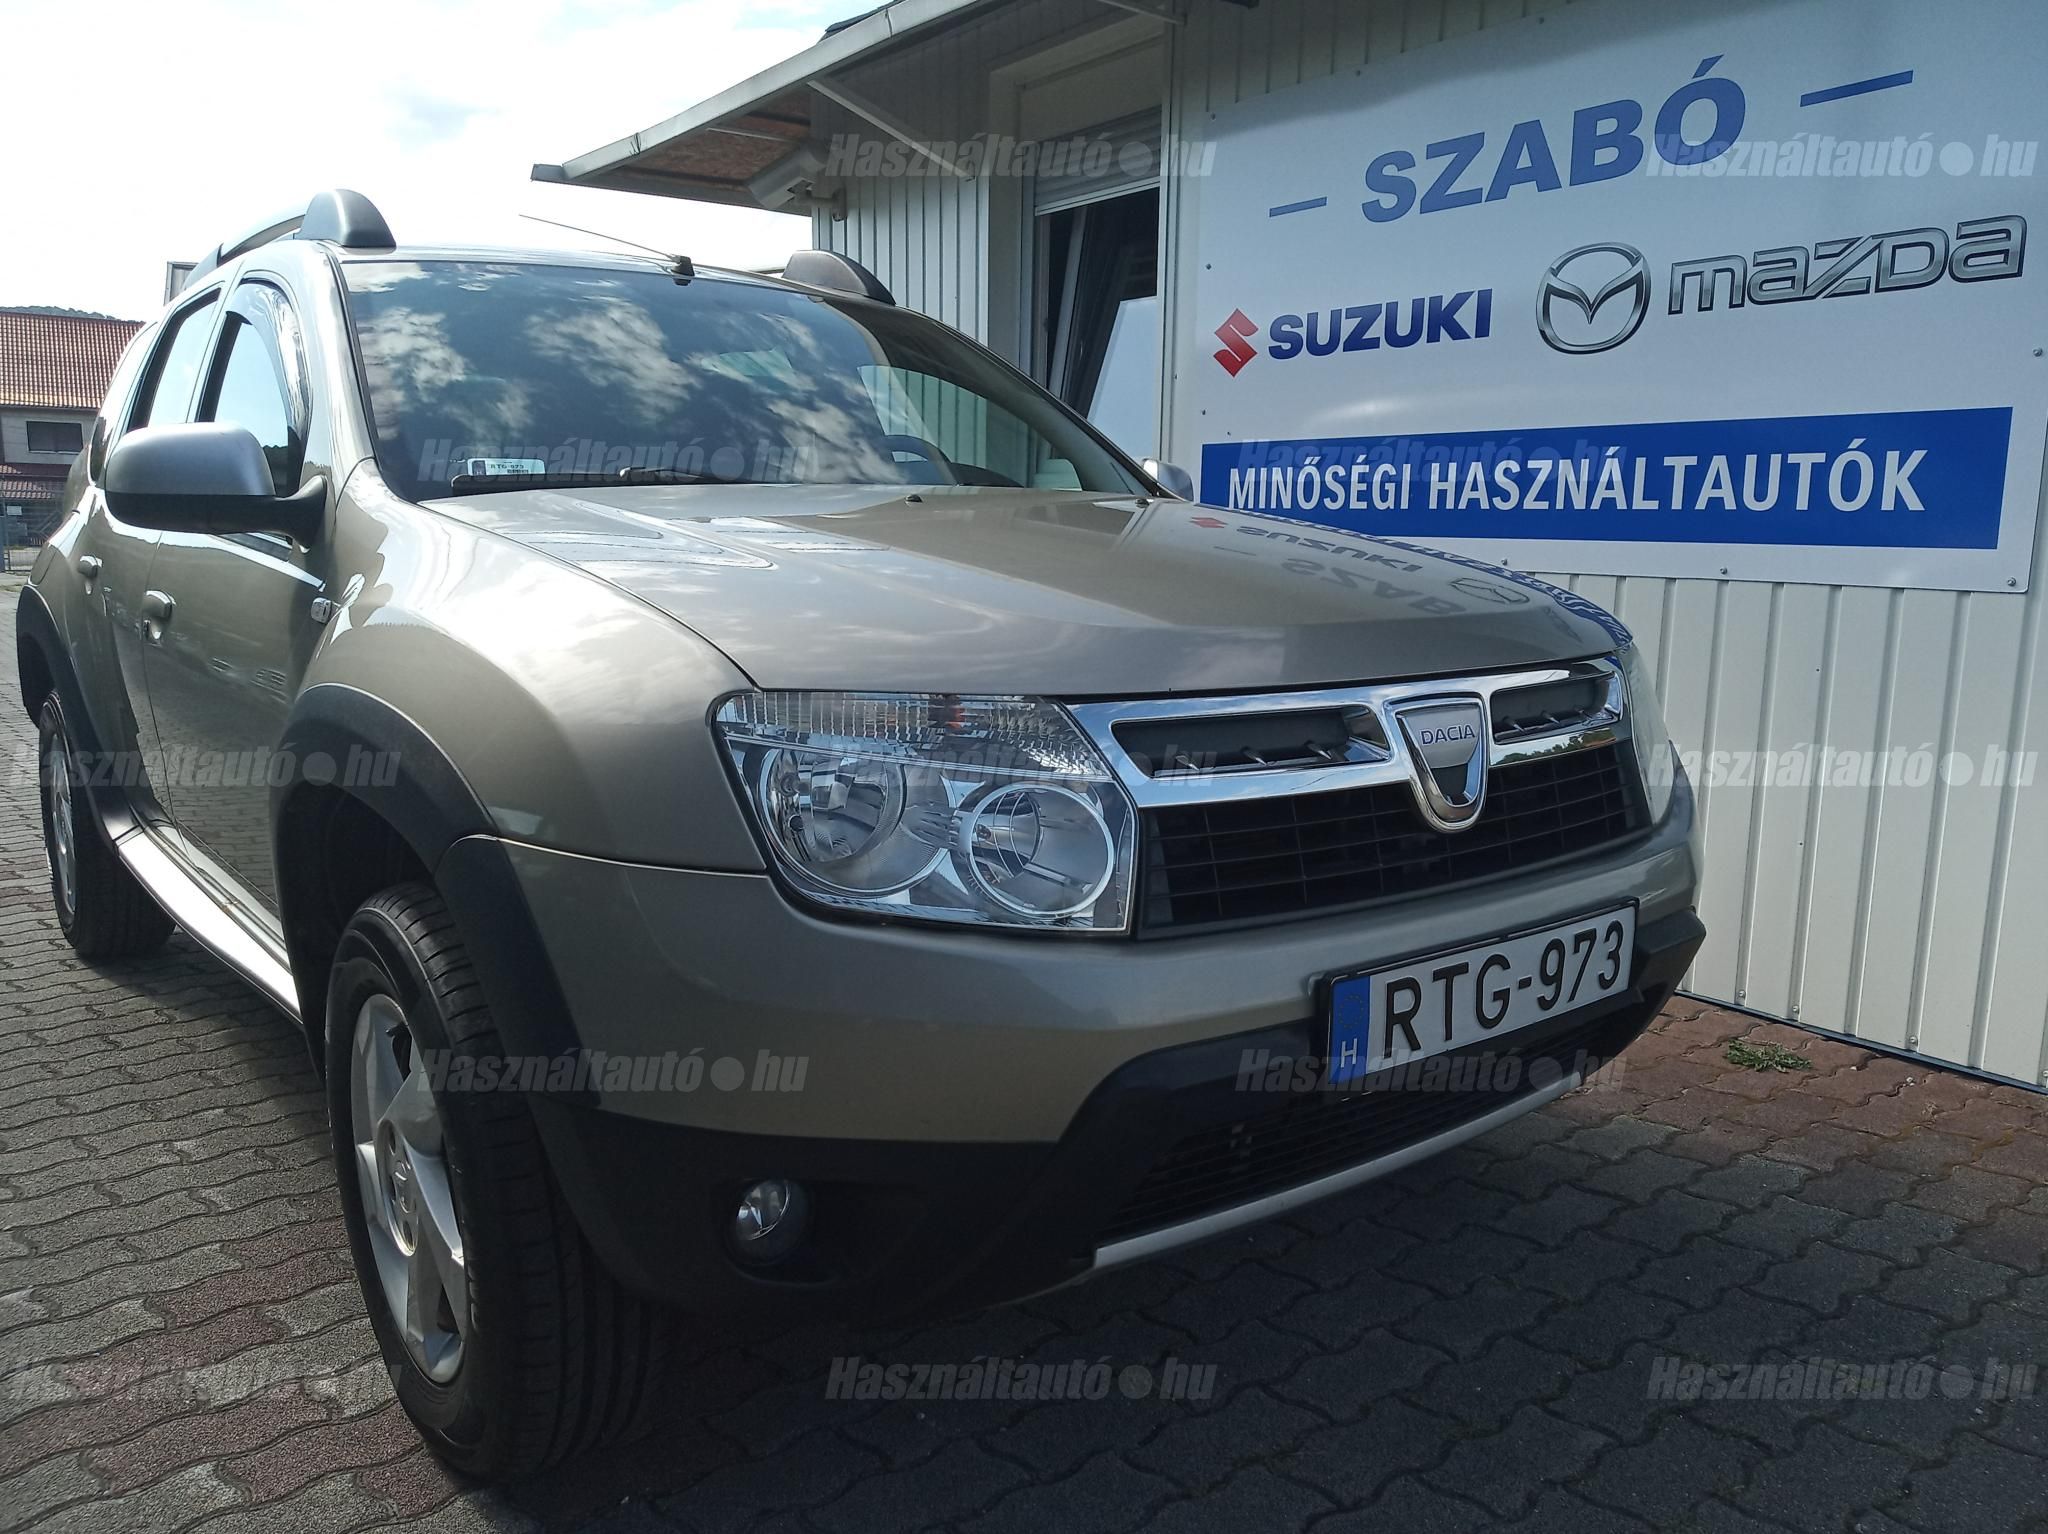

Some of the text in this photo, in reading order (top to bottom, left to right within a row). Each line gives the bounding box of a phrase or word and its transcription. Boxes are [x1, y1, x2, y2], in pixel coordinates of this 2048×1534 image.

[1362, 54, 1746, 223] SZABÓ
[1268, 288, 1493, 360] SUZUKI
[1228, 445, 1929, 512] MINŐSÉGI HASZNÁLTAUTÓK
[1420, 724, 1476, 745] DACIA
[1383, 919, 1625, 1060] RTG-973
[1340, 1037, 1359, 1069] H
